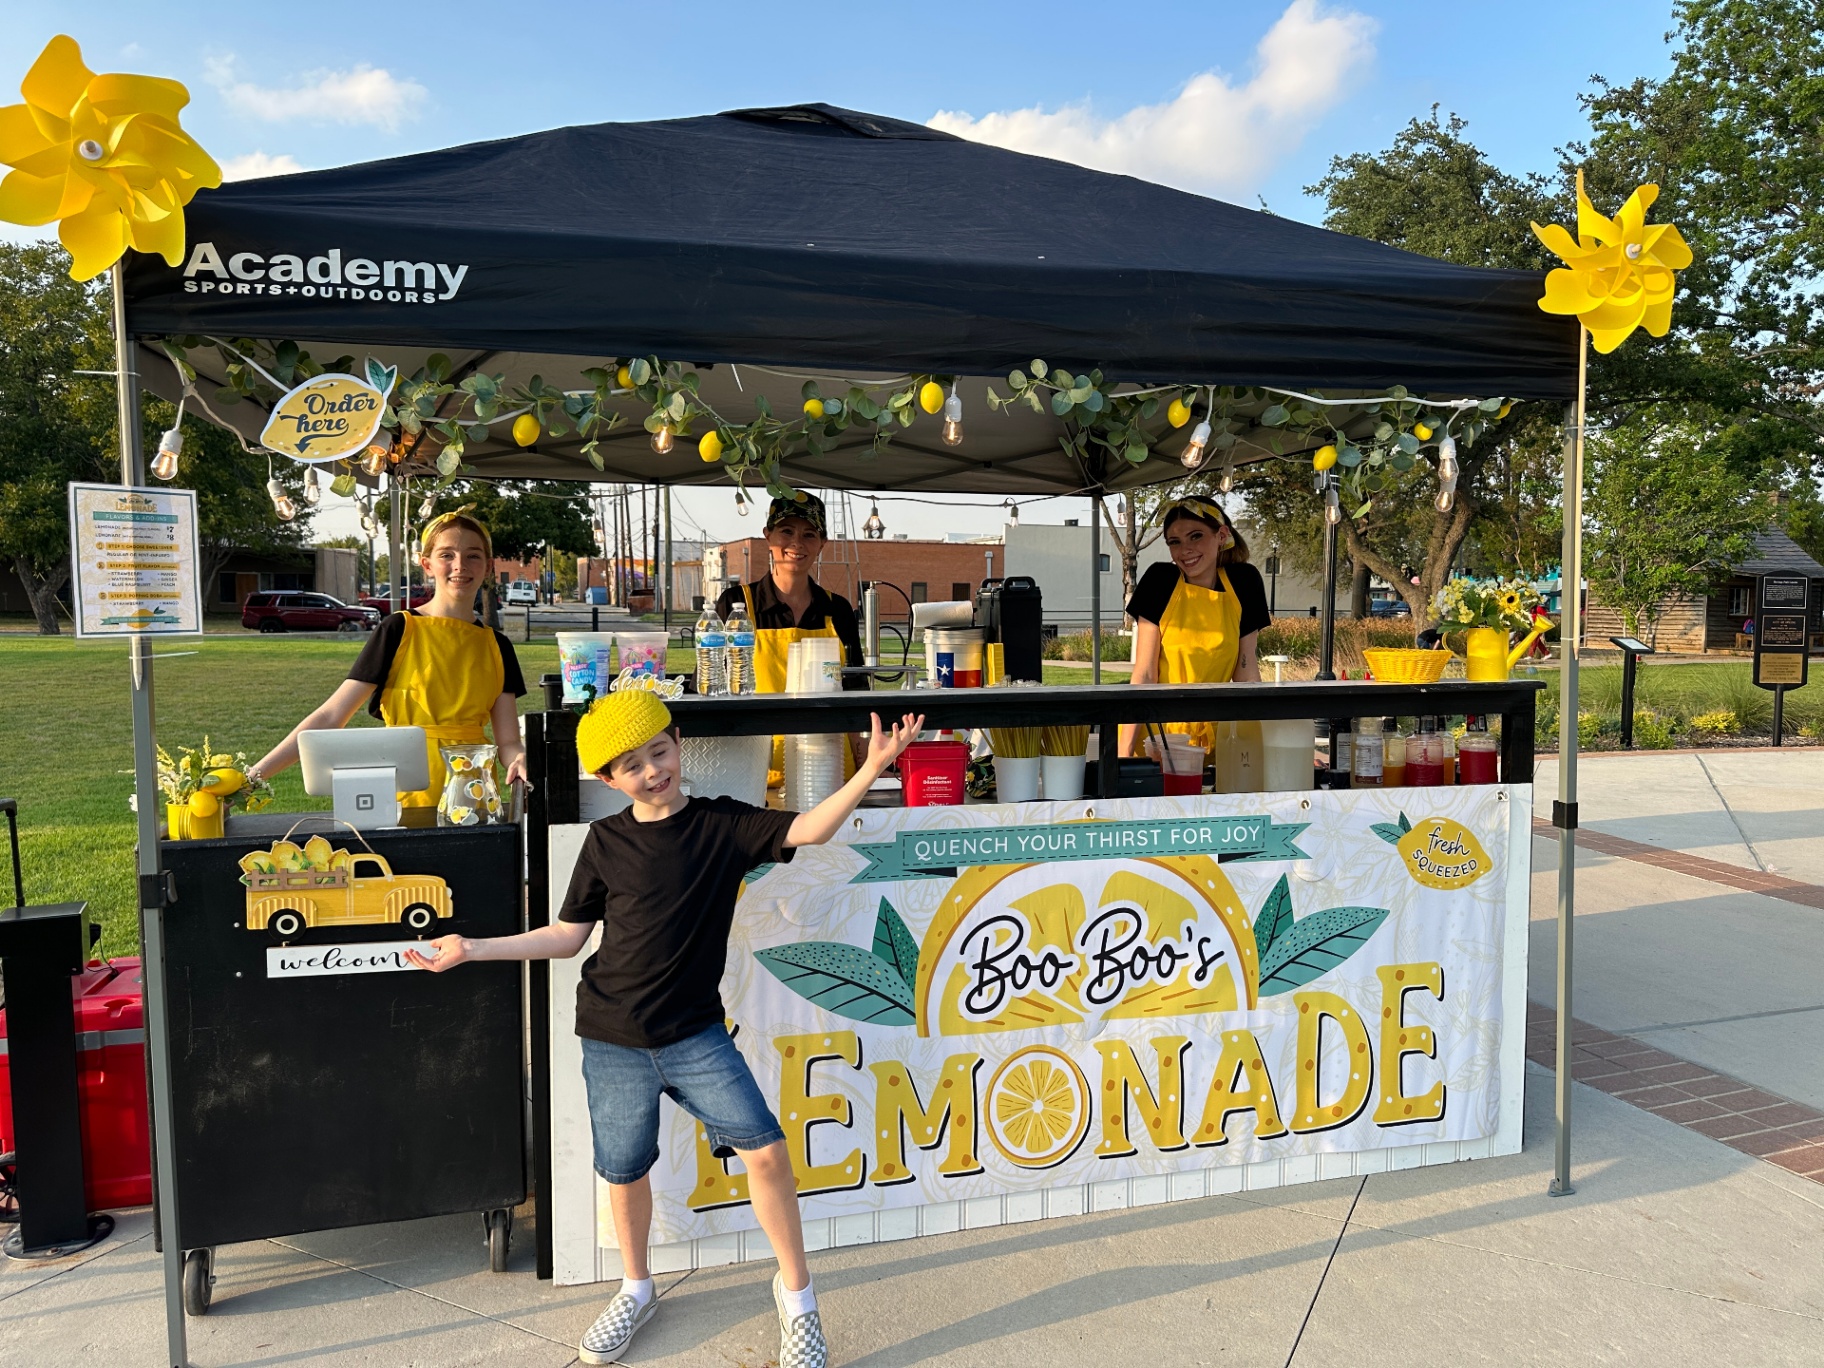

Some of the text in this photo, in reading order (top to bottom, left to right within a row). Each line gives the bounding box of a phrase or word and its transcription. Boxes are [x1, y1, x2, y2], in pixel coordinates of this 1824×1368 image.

[183, 242, 469, 300] Academy
[184, 281, 436, 304] SPORTS+OUTDOORS
[304, 393, 378, 415] Order
[279, 413, 349, 433] here
[569, 668, 595, 678] COTTON
[914, 825, 1261, 862] QUENCH YOUR THIRST FOR JOY
[1428, 826, 1471, 856] fresh
[1412, 849, 1477, 878] SQUEEZED
[279, 947, 410, 971] welcom
[959, 907, 1226, 1016] Boo Boo's
